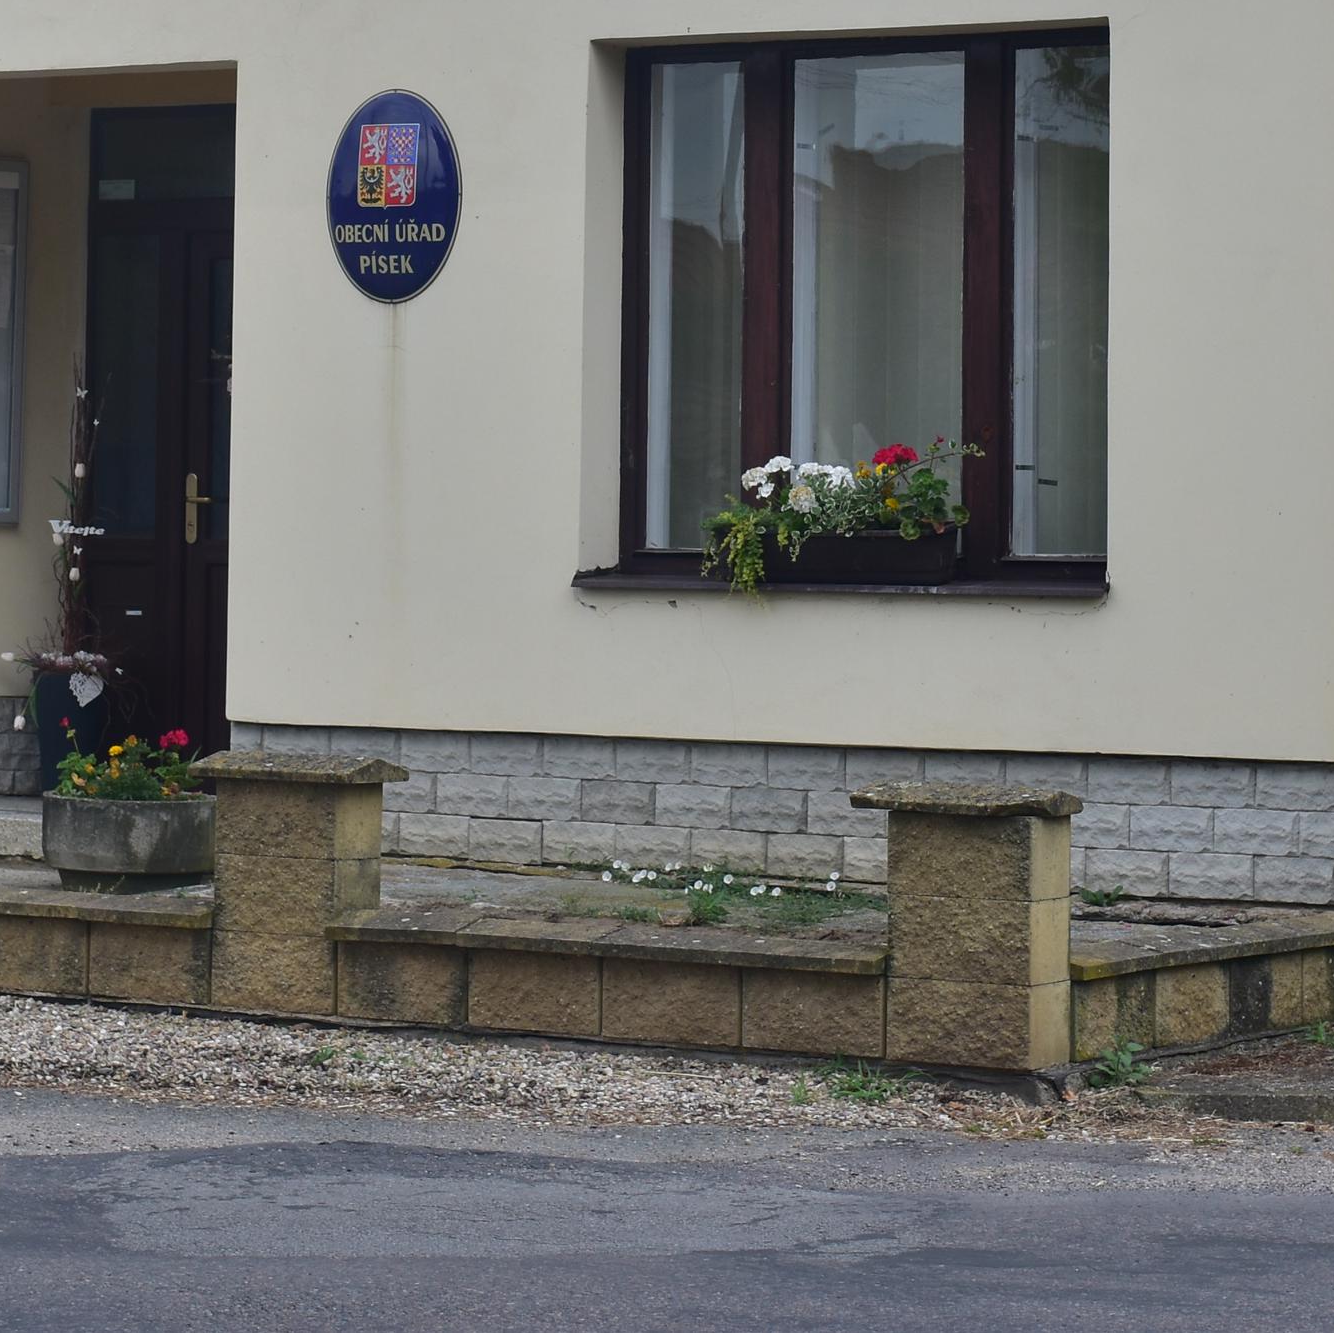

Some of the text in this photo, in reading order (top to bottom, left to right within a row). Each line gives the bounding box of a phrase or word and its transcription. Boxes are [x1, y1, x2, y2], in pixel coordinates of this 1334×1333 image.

[335, 218, 446, 244] OBECNÍ ÚŘAD
[359, 250, 414, 275] PÍSEK
